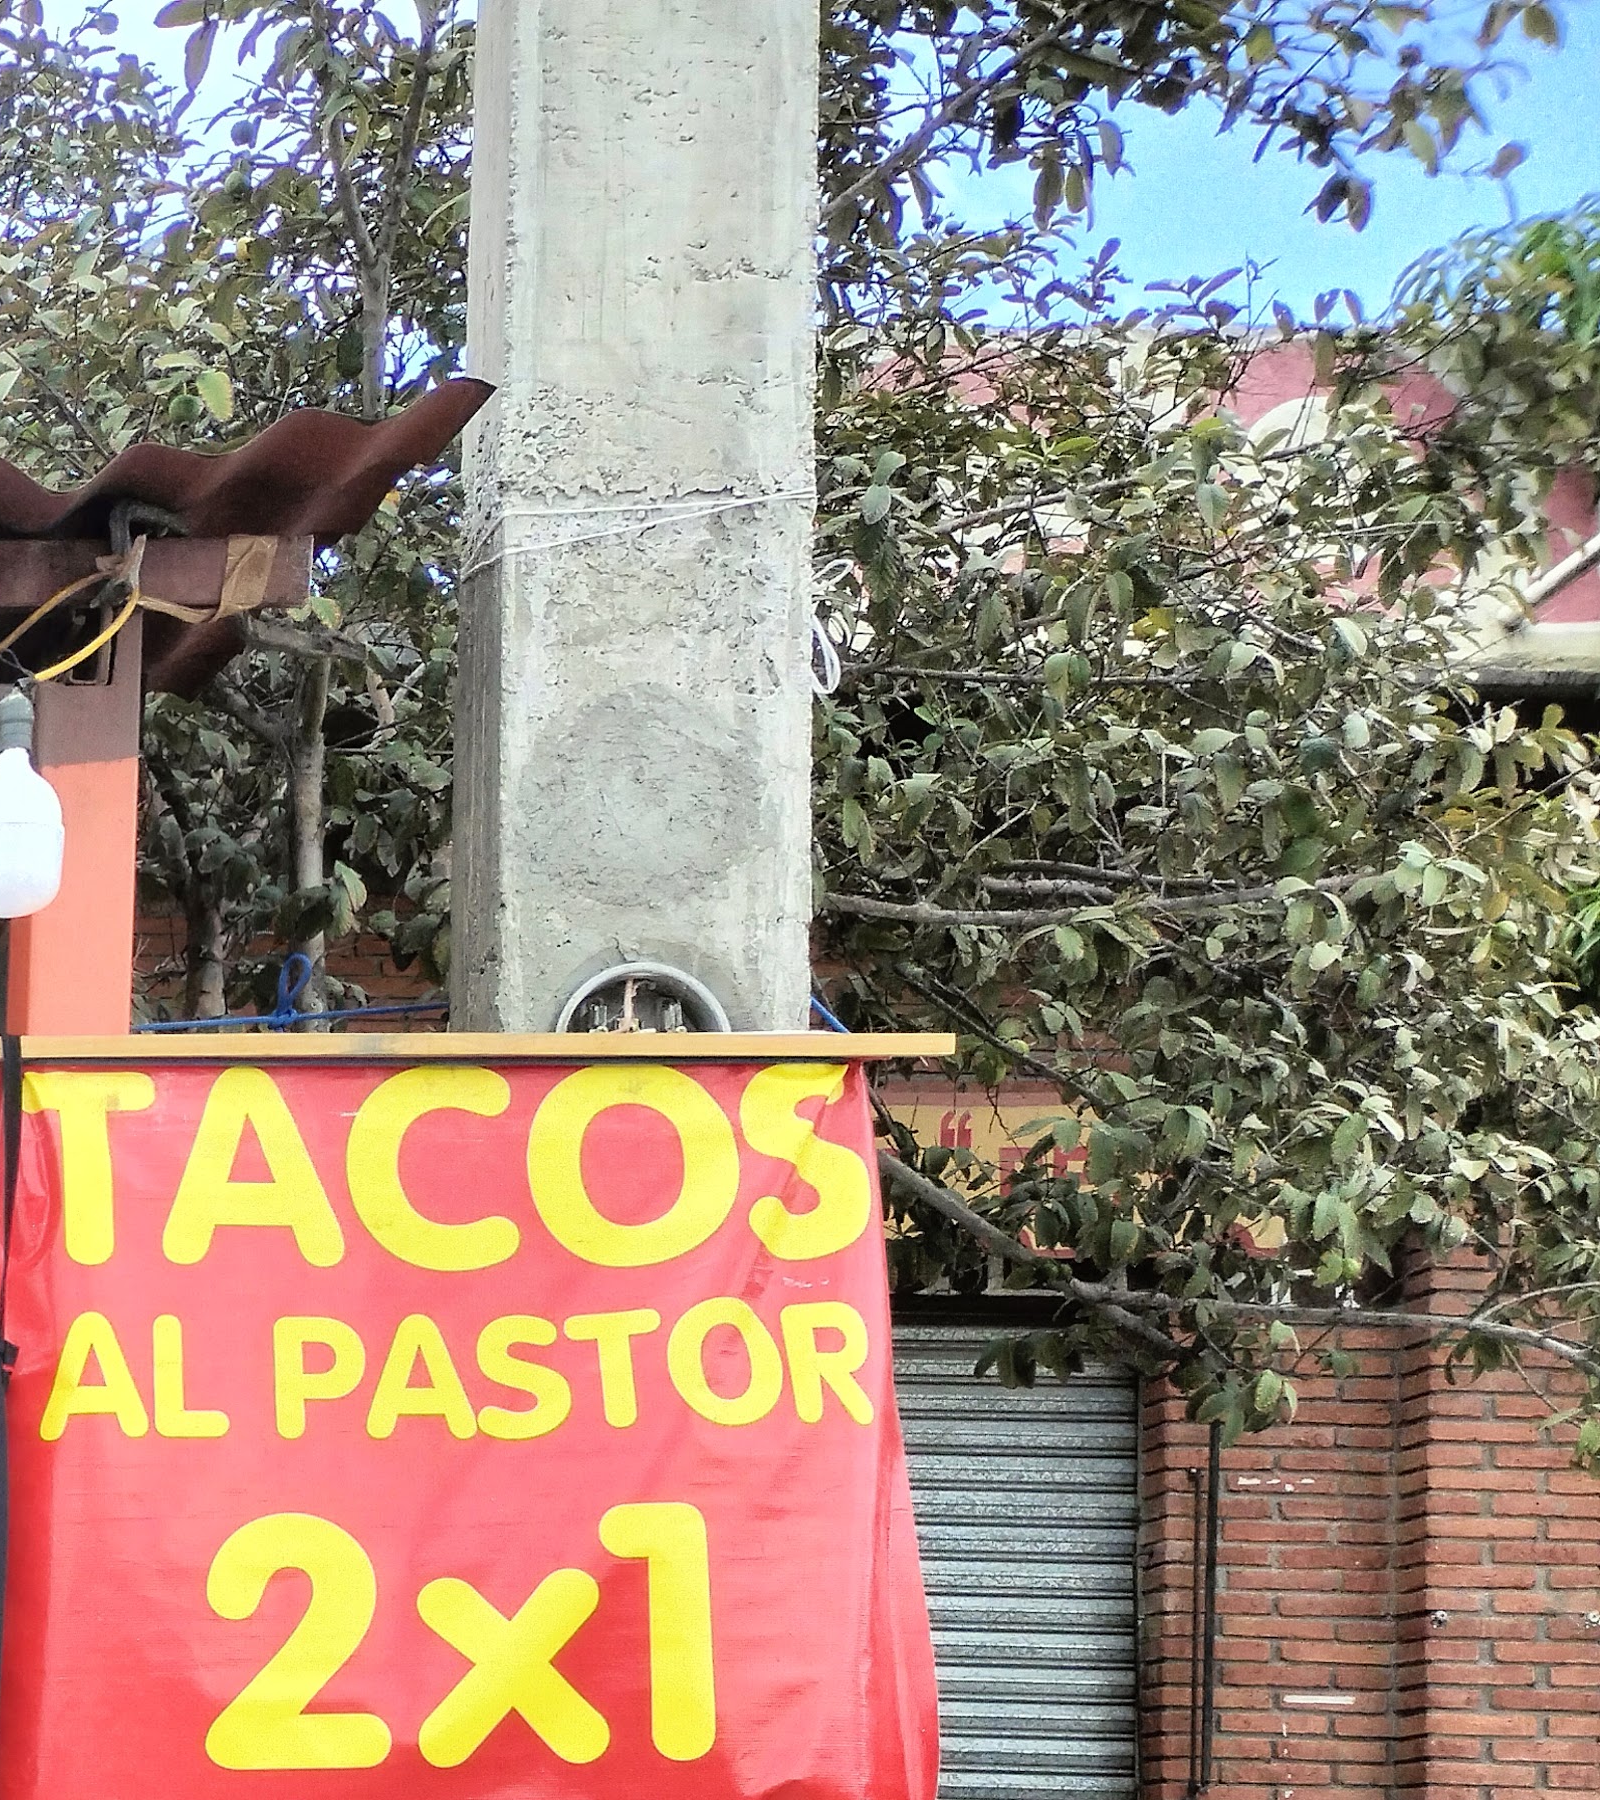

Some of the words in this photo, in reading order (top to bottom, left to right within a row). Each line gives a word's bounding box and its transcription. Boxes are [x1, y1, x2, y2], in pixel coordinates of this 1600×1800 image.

[20, 1061, 873, 1272] TACOS
[39, 1312, 230, 1443] AL
[275, 1295, 876, 1441] PASTOR
[204, 1500, 719, 1772] 2x1
